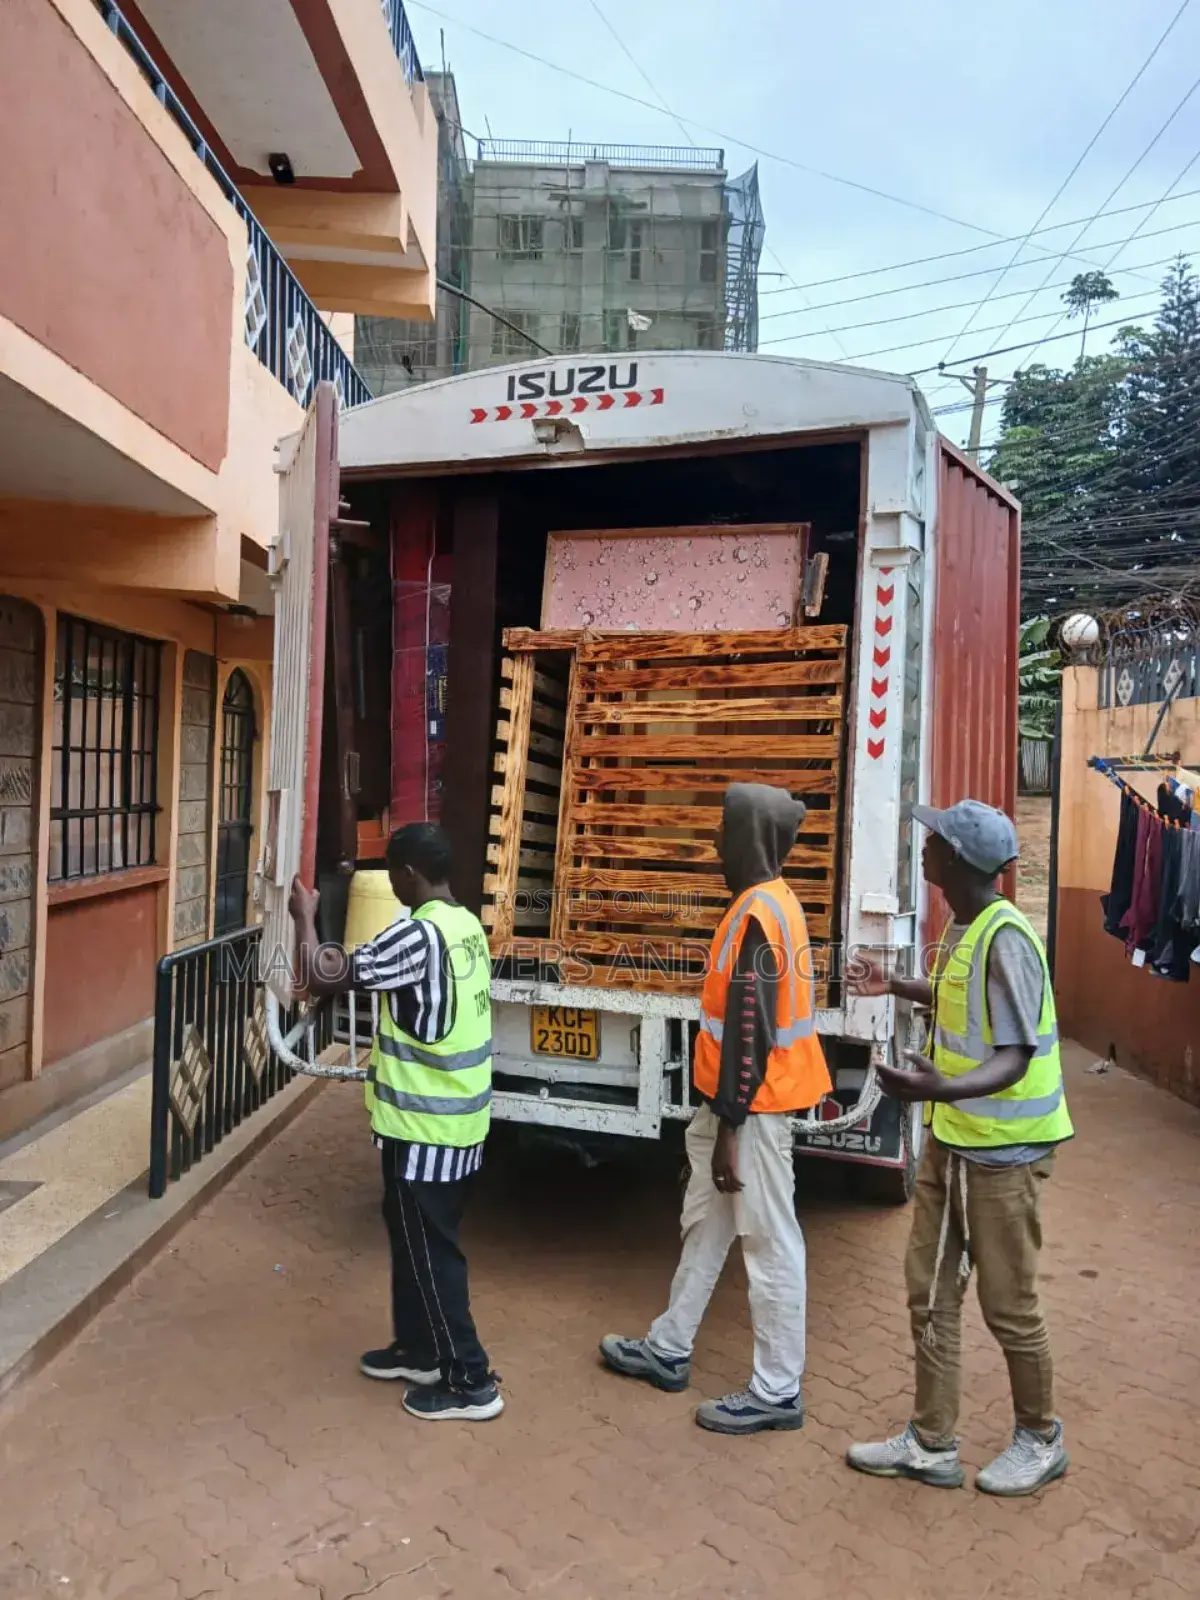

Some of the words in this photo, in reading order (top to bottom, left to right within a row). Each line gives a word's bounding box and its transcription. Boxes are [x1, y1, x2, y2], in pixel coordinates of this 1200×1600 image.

[507, 363, 638, 400] ISUZU
[548, 1006, 593, 1029] KCF
[537, 1028, 591, 1056] 230D
[806, 1132, 881, 1152] ISUZU
